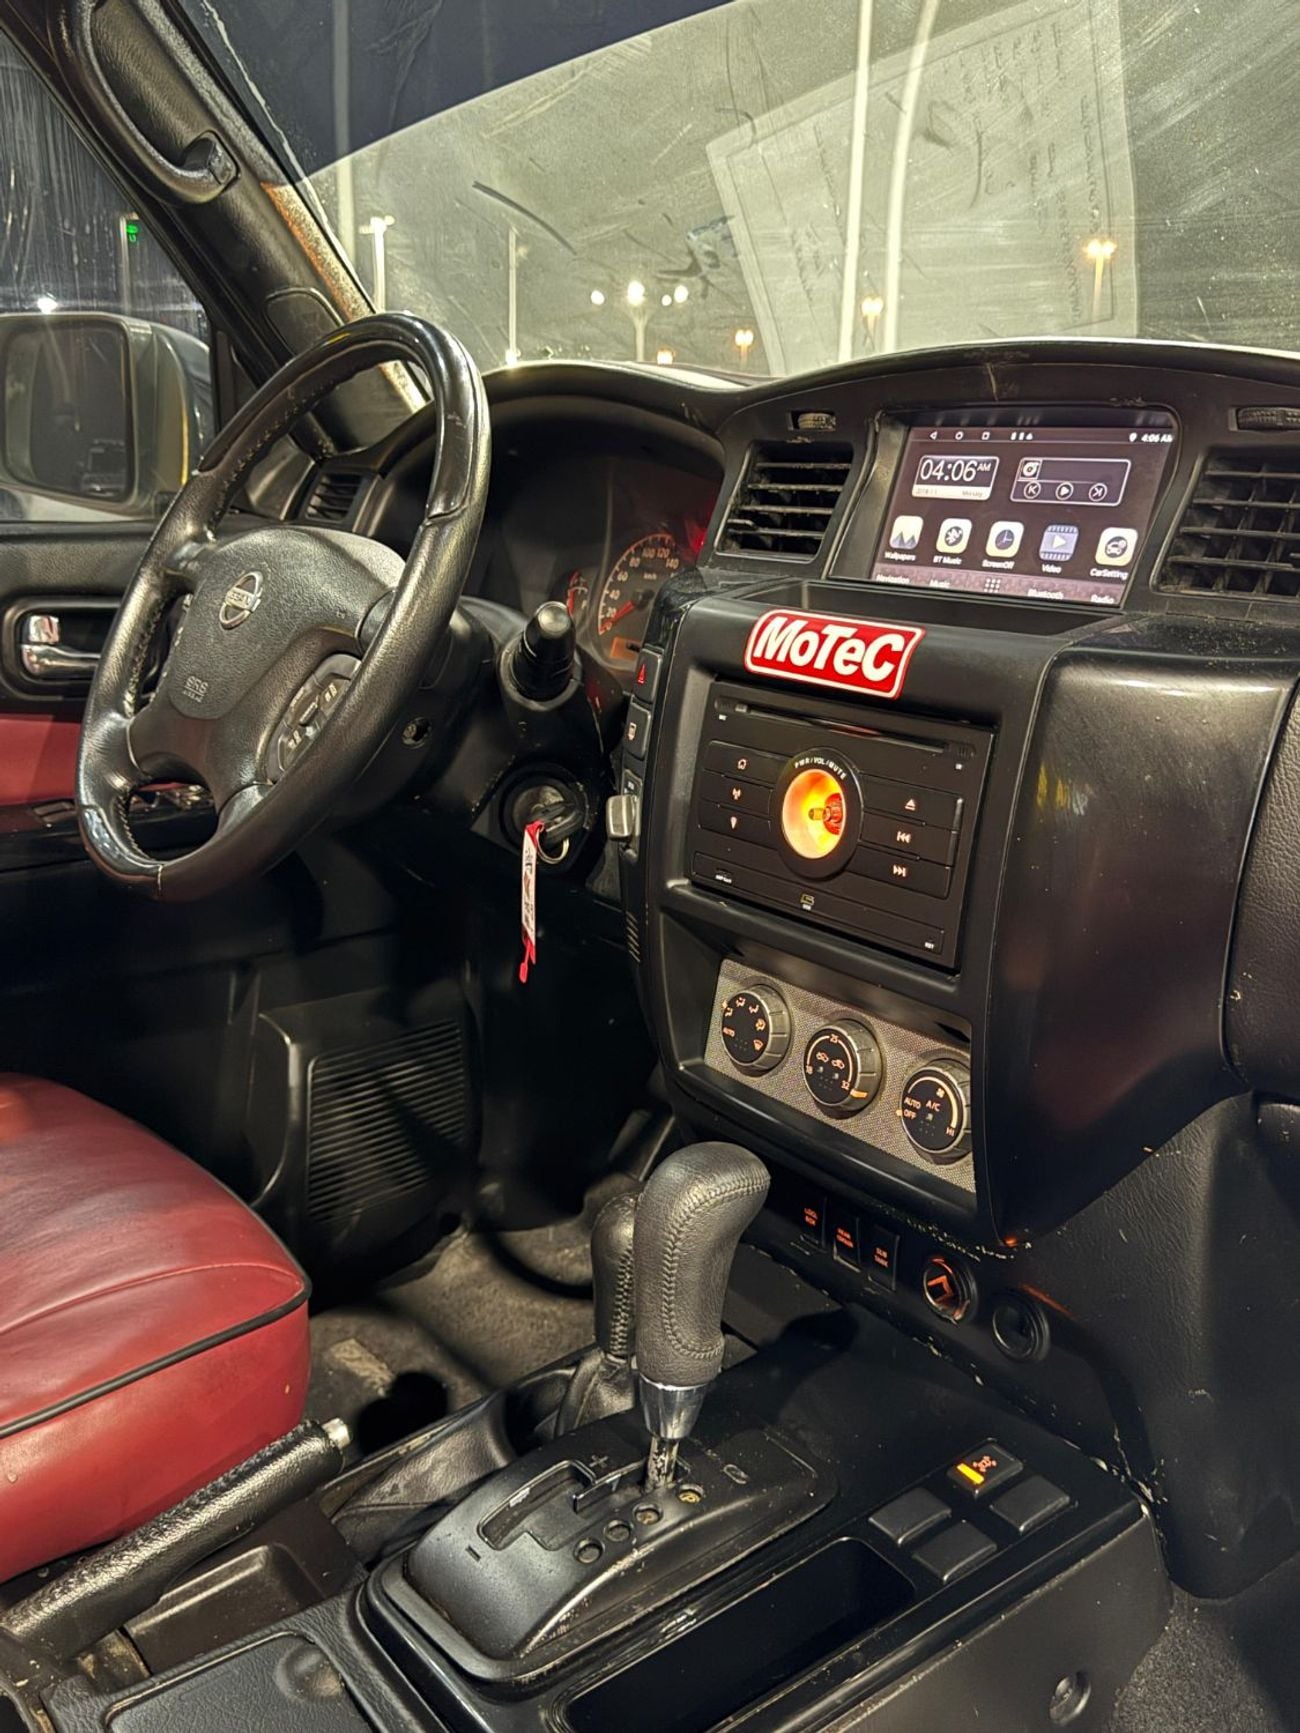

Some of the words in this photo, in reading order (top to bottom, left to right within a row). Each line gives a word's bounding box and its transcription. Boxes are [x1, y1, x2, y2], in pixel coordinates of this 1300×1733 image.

[920, 459, 978, 482] 04:06
[977, 462, 992, 472] AM
[666, 559, 679, 569] 140
[1041, 564, 1062, 574] Video
[617, 572, 628, 581] 60
[1090, 568, 1129, 581] CarSetting
[609, 590, 621, 600] 40
[752, 616, 906, 682] MoTeC
[186, 675, 209, 693] SRS
[904, 1096, 922, 1110] AUTO
[925, 1099, 941, 1113] A/C
[903, 1108, 917, 1120] OFF
